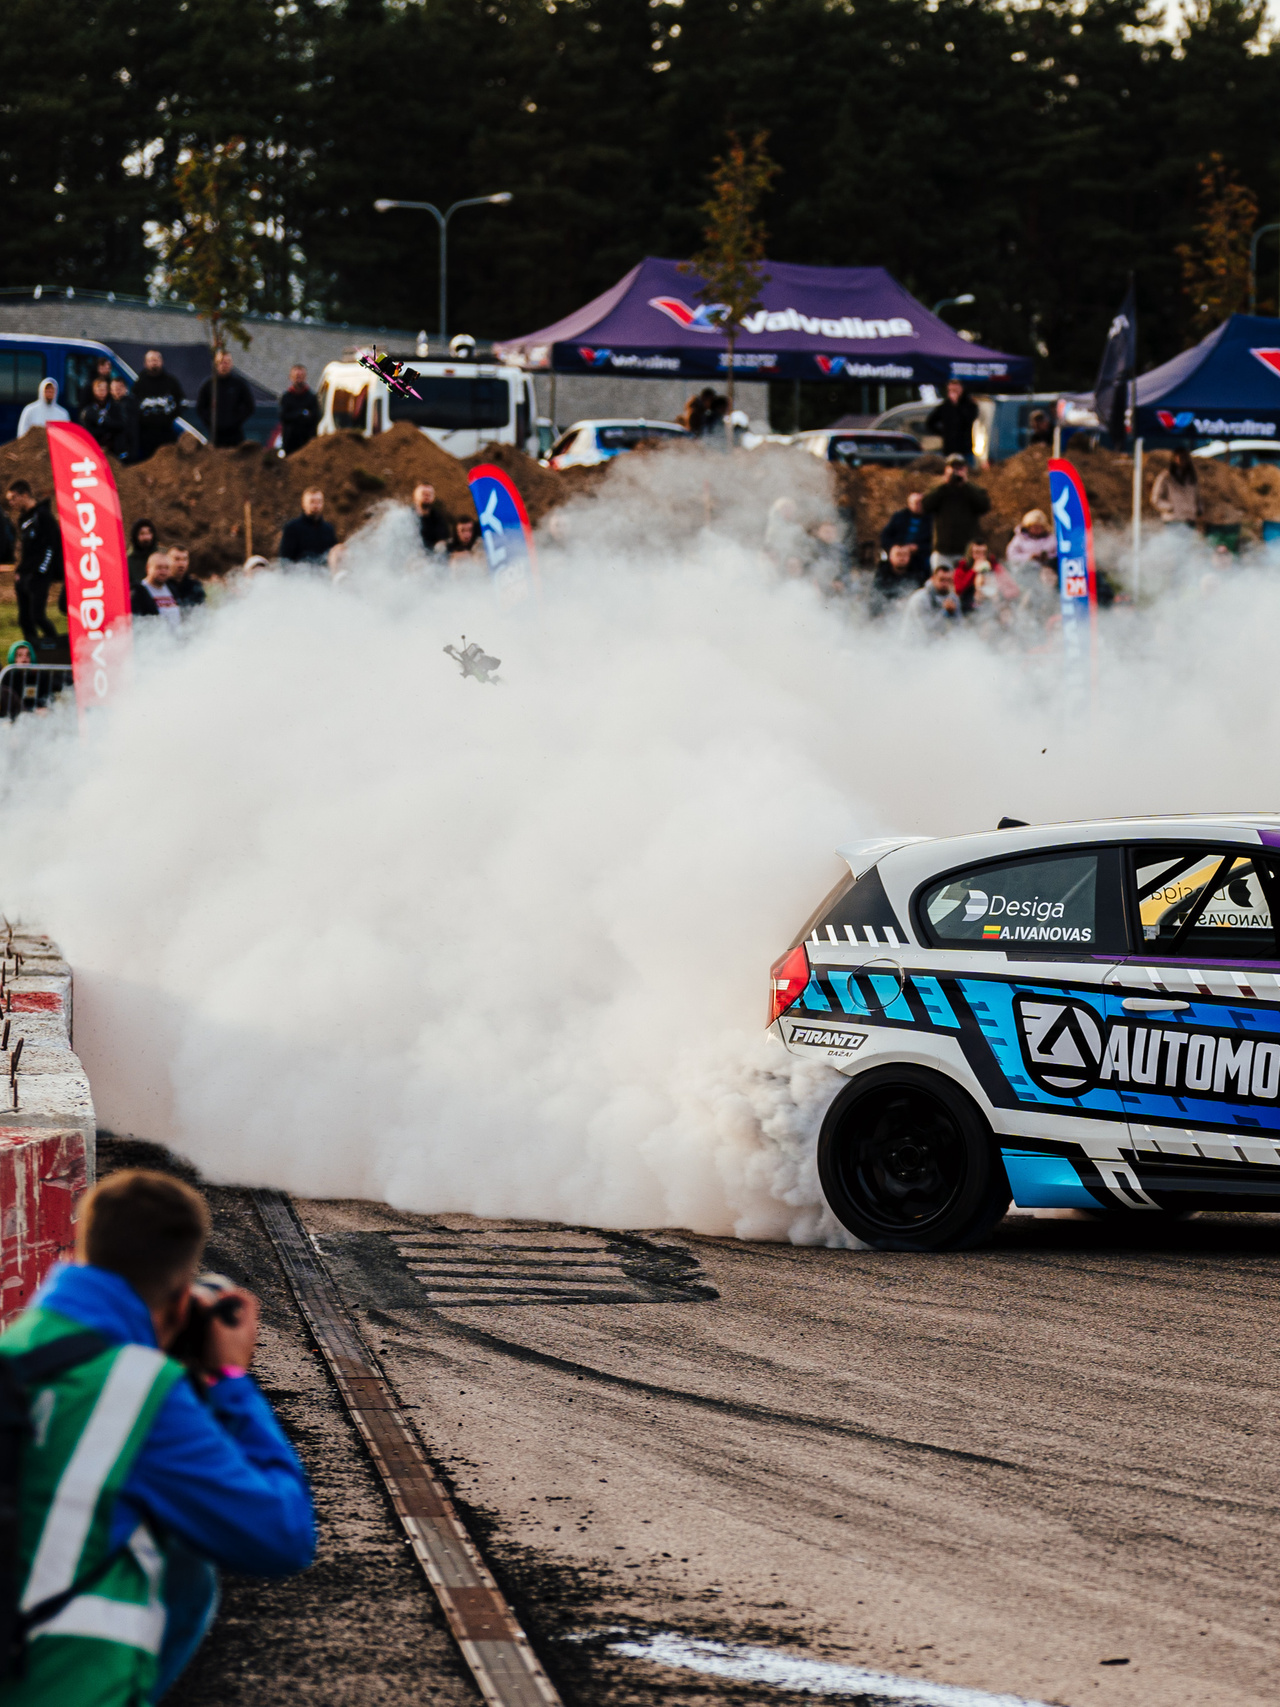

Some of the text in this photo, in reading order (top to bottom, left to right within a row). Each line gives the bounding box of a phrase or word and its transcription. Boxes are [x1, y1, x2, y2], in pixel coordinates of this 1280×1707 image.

[740, 308, 914, 339] Valvoline
[988, 895, 1065, 922] Desiga
[999, 926, 1092, 942] A.IVANOVAS
[792, 1028, 865, 1048] FIRANTO
